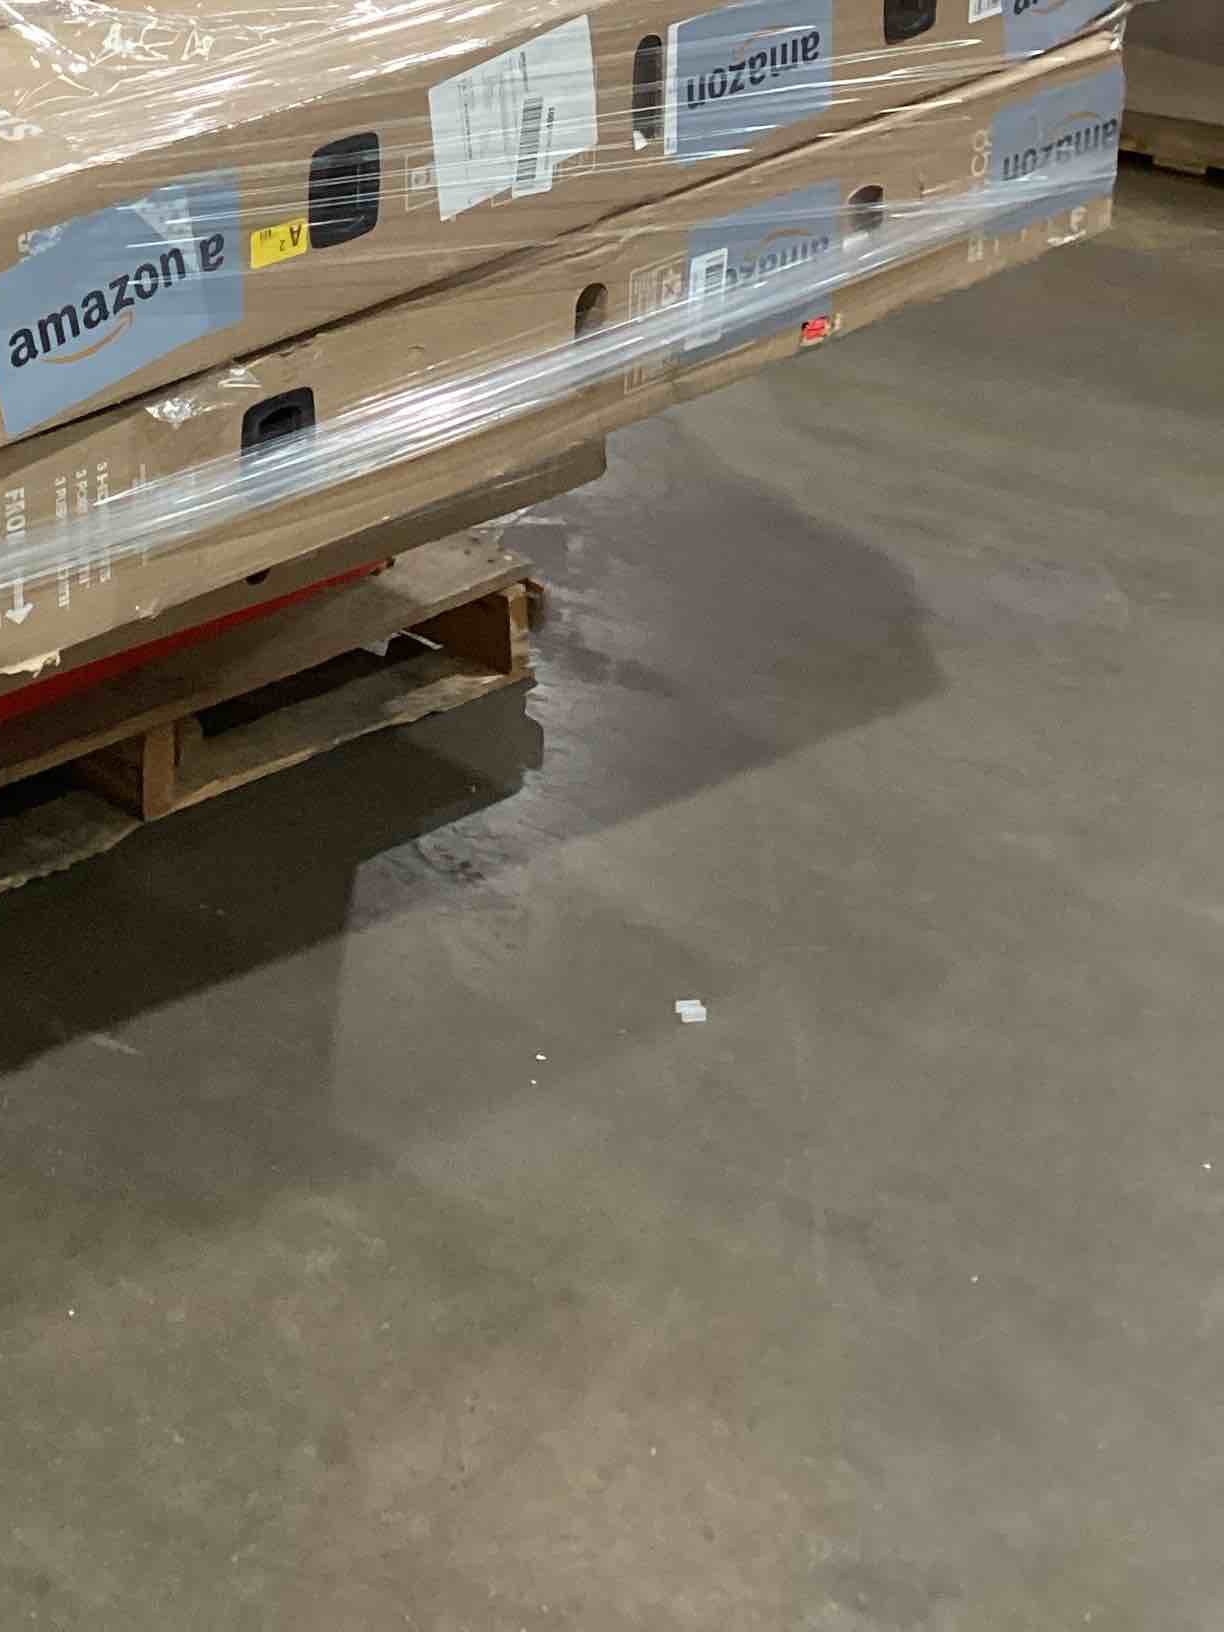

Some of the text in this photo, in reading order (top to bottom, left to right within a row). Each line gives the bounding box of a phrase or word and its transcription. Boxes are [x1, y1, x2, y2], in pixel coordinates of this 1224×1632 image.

[686, 30, 820, 111] amazon
[1002, 118, 1118, 180] amazon
[727, 236, 829, 287] amazo
[7, 246, 187, 369] amazon
